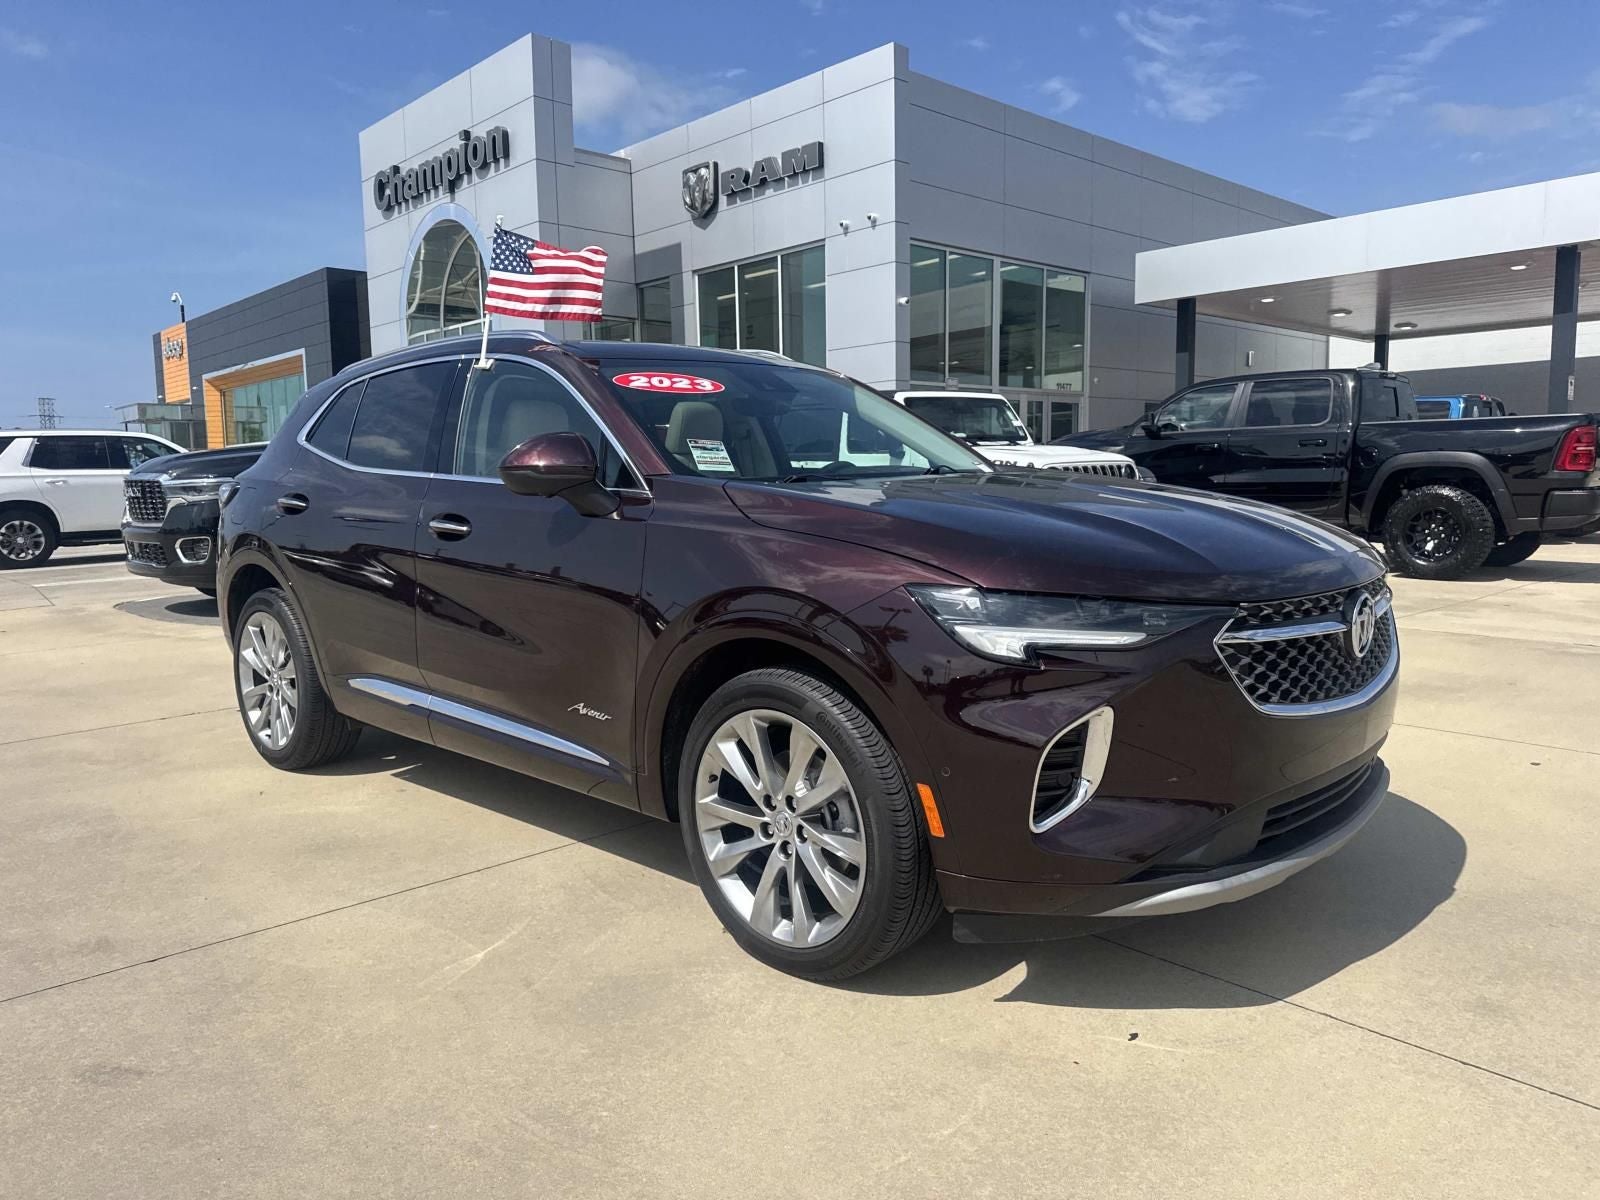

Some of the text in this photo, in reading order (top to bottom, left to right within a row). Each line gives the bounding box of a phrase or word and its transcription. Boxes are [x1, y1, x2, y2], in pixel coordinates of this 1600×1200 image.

[374, 126, 509, 211] Champion
[721, 141, 824, 196] RAM
[628, 376, 715, 391] 2023
[567, 702, 612, 720] Avenir
